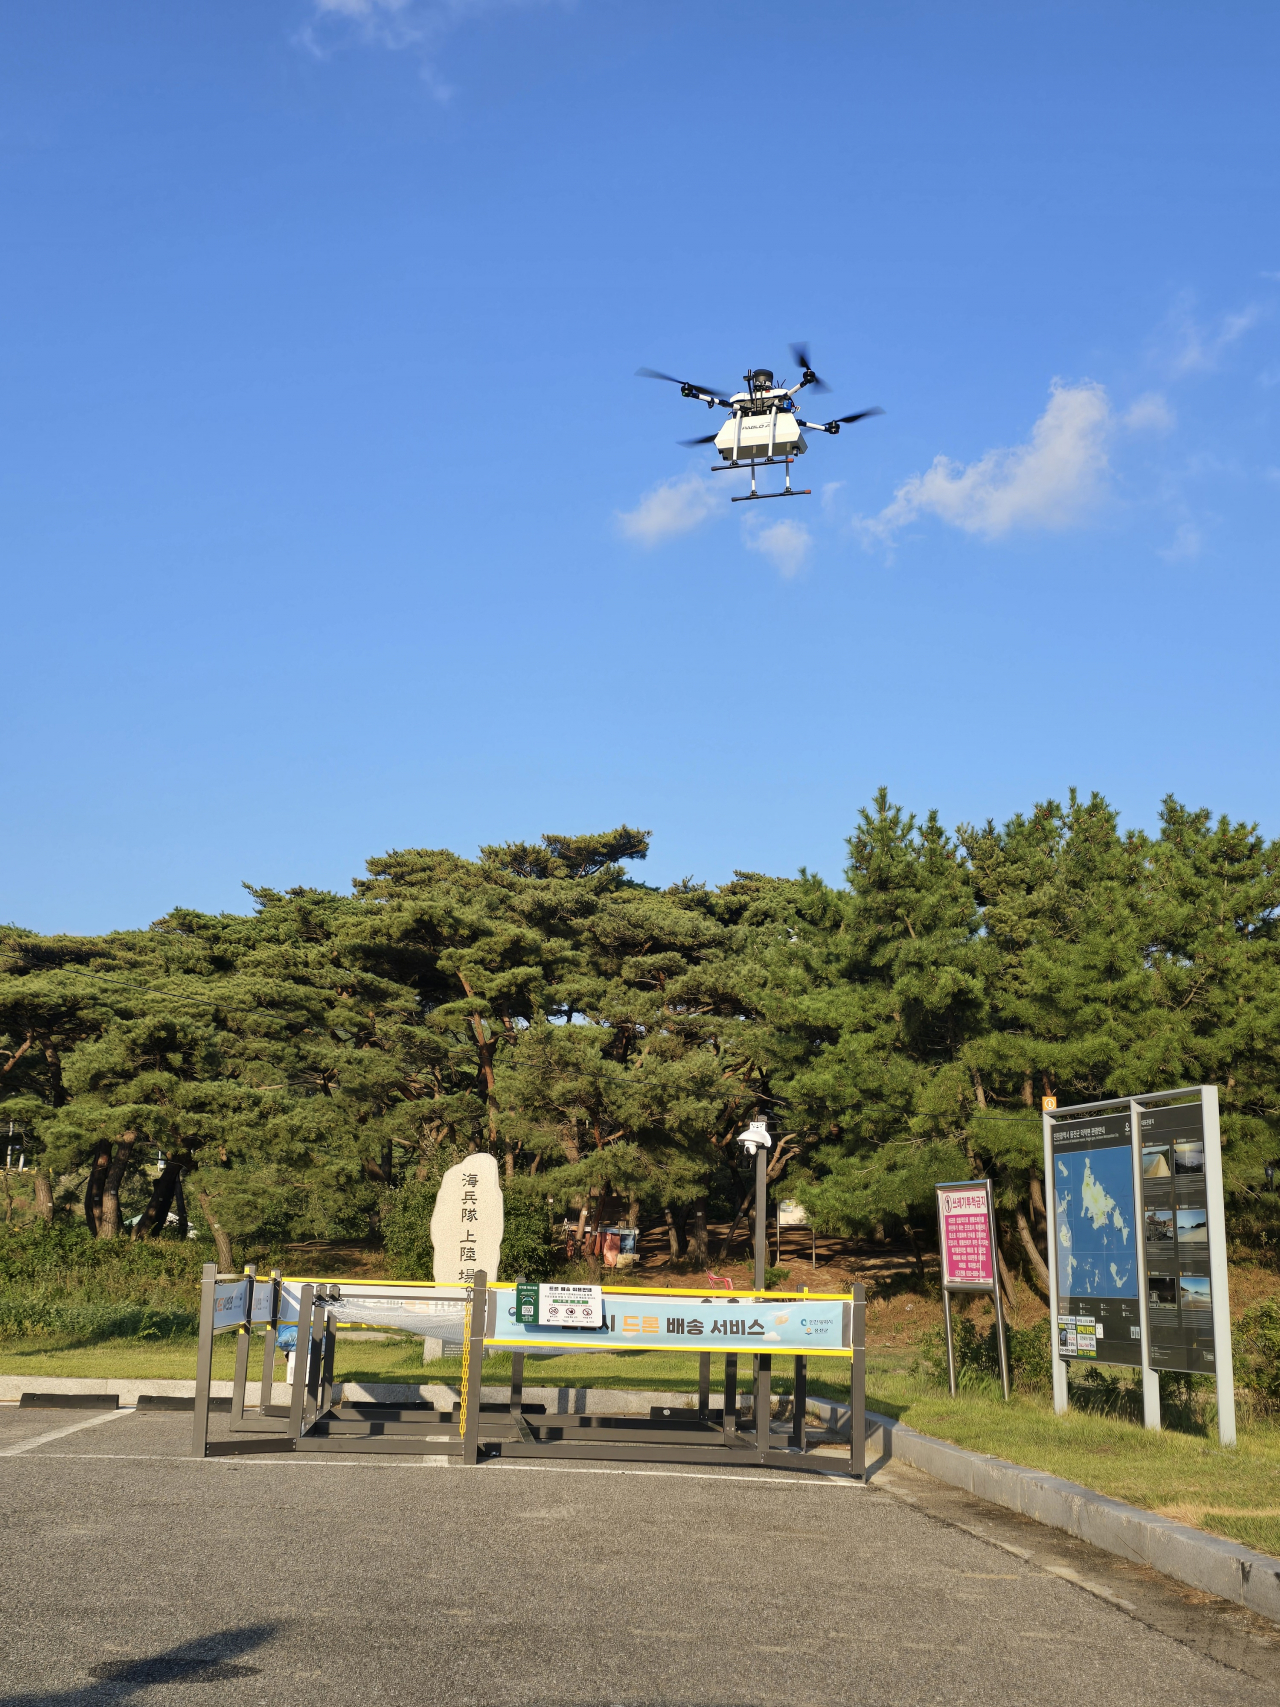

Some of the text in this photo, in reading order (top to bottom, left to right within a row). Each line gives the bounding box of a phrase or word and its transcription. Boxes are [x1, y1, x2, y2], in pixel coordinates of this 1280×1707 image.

[953, 1196, 986, 1209] 쓰레기투척금지
[622, 1315, 660, 1334] 드론
[666, 1317, 704, 1336] 배송
[710, 1319, 765, 1336] 서비스
